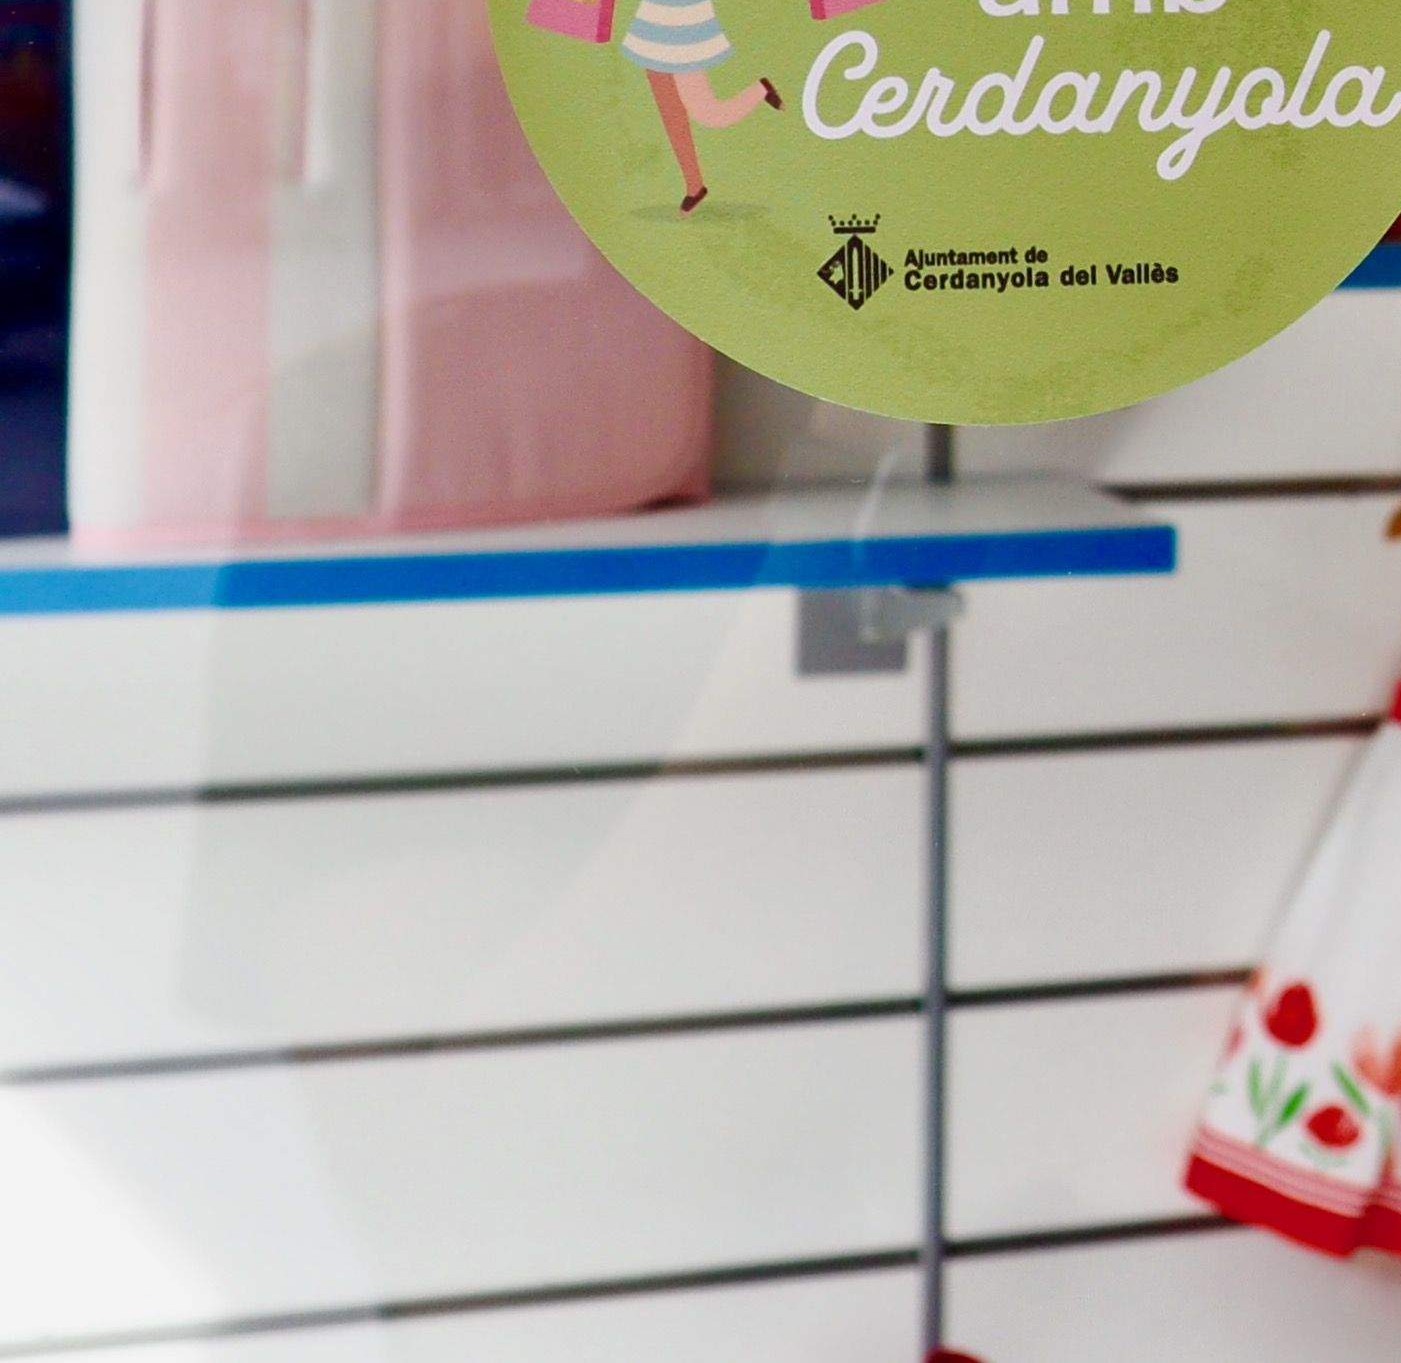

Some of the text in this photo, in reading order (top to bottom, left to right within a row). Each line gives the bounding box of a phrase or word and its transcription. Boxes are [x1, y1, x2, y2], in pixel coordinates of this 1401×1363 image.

[904, 246, 1048, 270] Ajuntament de
[904, 263, 1179, 293] Cerdanyola del Vallès
